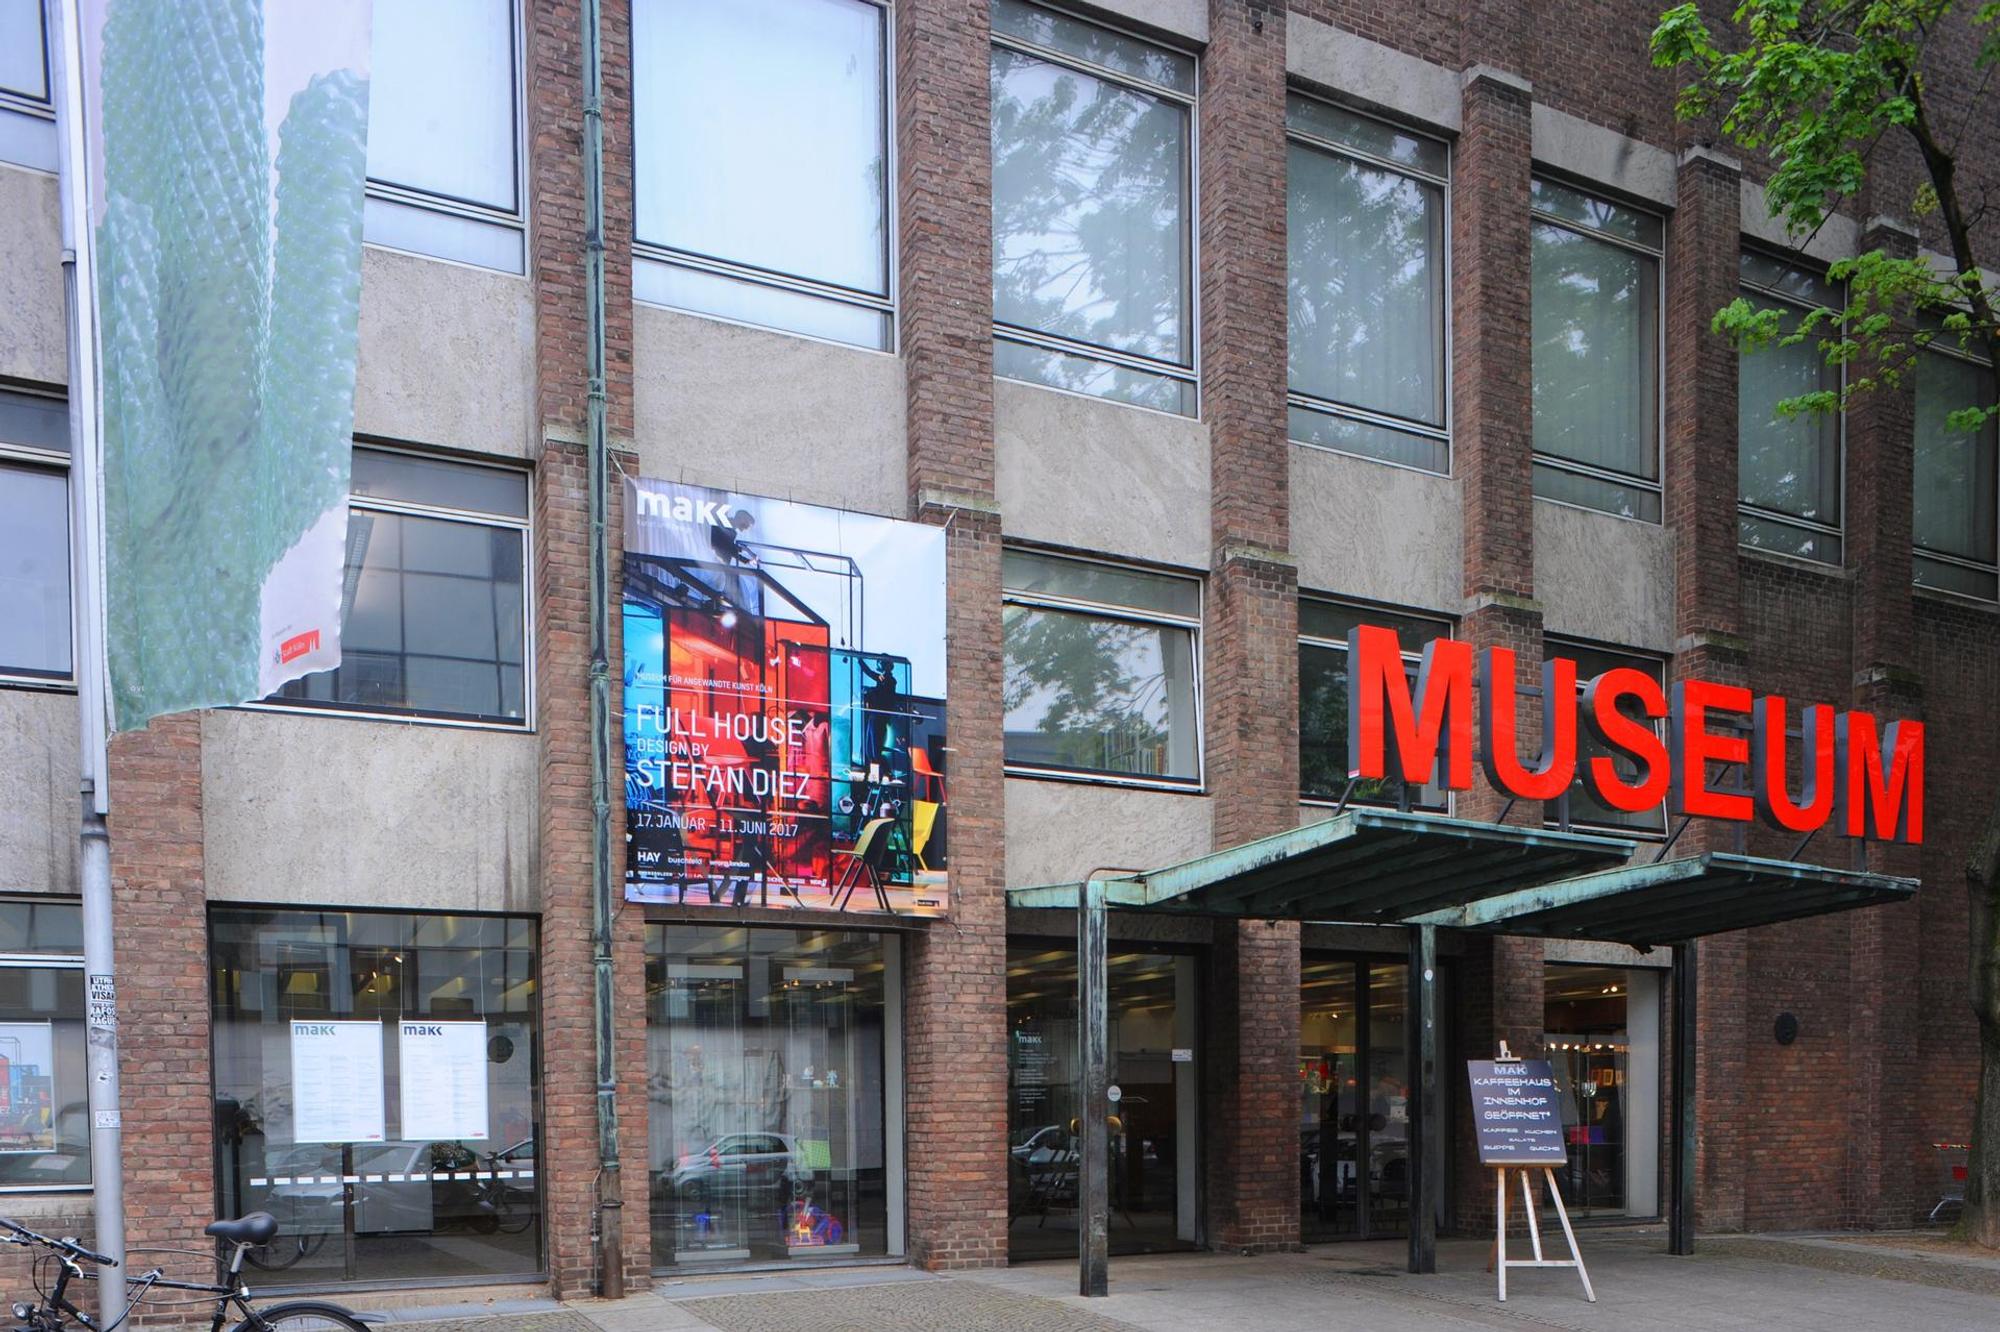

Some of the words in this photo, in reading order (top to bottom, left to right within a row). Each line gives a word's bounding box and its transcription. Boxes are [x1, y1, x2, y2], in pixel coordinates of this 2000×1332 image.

[732, 682, 754, 692] KUNST
[755, 683, 773, 694] KÖLN
[636, 703, 707, 738] FULL
[714, 711, 804, 747] HOUSE
[1347, 624, 1925, 844] MUSEUM
[637, 737, 688, 755] DESIGN
[691, 743, 710, 757] BY
[636, 759, 744, 796] STEFAN
[752, 768, 811, 800] DIEZ
[637, 813, 654, 828] 17.
[656, 814, 706, 831] JANUAR
[719, 819, 738, 833] 11.
[739, 820, 767, 835] JUNI
[769, 821, 799, 837] 2017
[637, 851, 661, 863] HAY
[1473, 1078, 1552, 1087] KAFFEEHAUS
[1507, 1088, 1521, 1096] IM
[1483, 1096, 1548, 1106] INNENHOF
